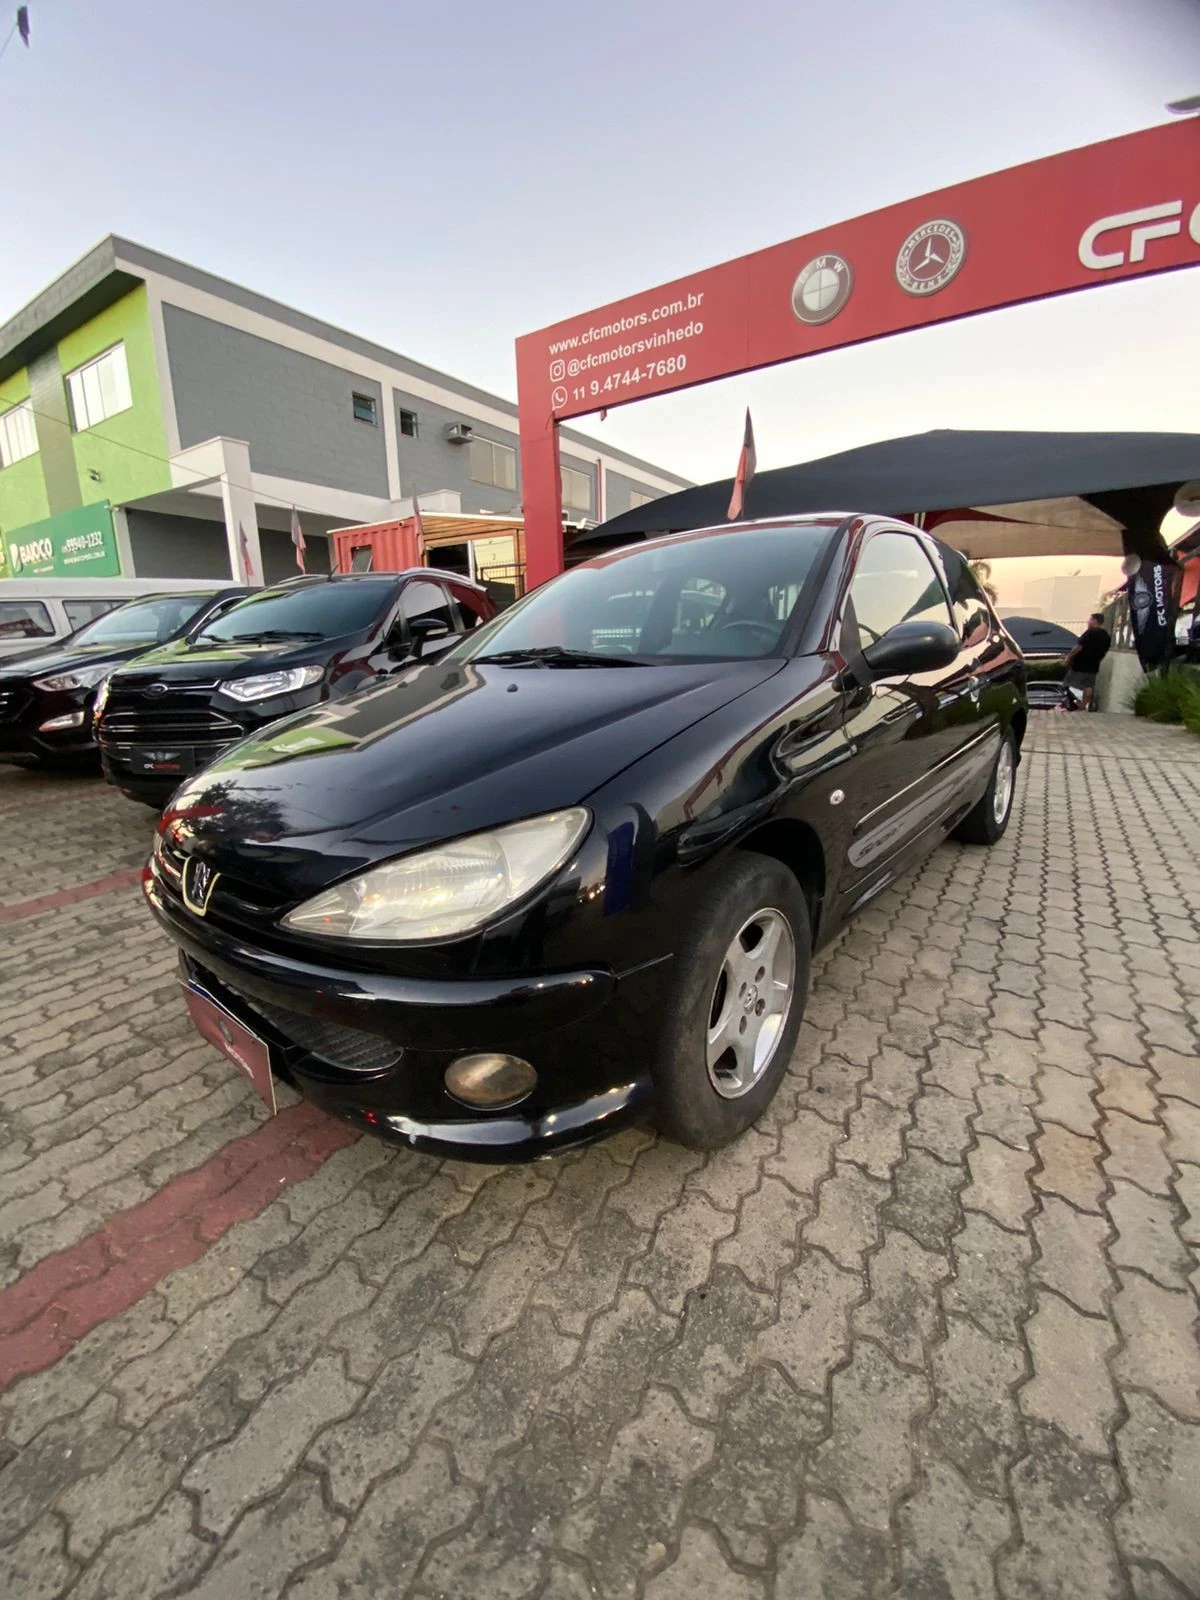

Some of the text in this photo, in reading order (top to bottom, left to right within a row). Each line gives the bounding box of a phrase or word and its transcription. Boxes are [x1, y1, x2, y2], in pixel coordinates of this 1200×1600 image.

[907, 223, 956, 251] MERCEDES
[1078, 200, 1200, 270] CF
[549, 292, 704, 355] www.cfcmotors.com.br
[567, 321, 704, 377] @cfcmotorsvinhedo
[572, 354, 687, 401] 11 9.4744-7680
[1153, 564, 1167, 626] CFC MOTORS
